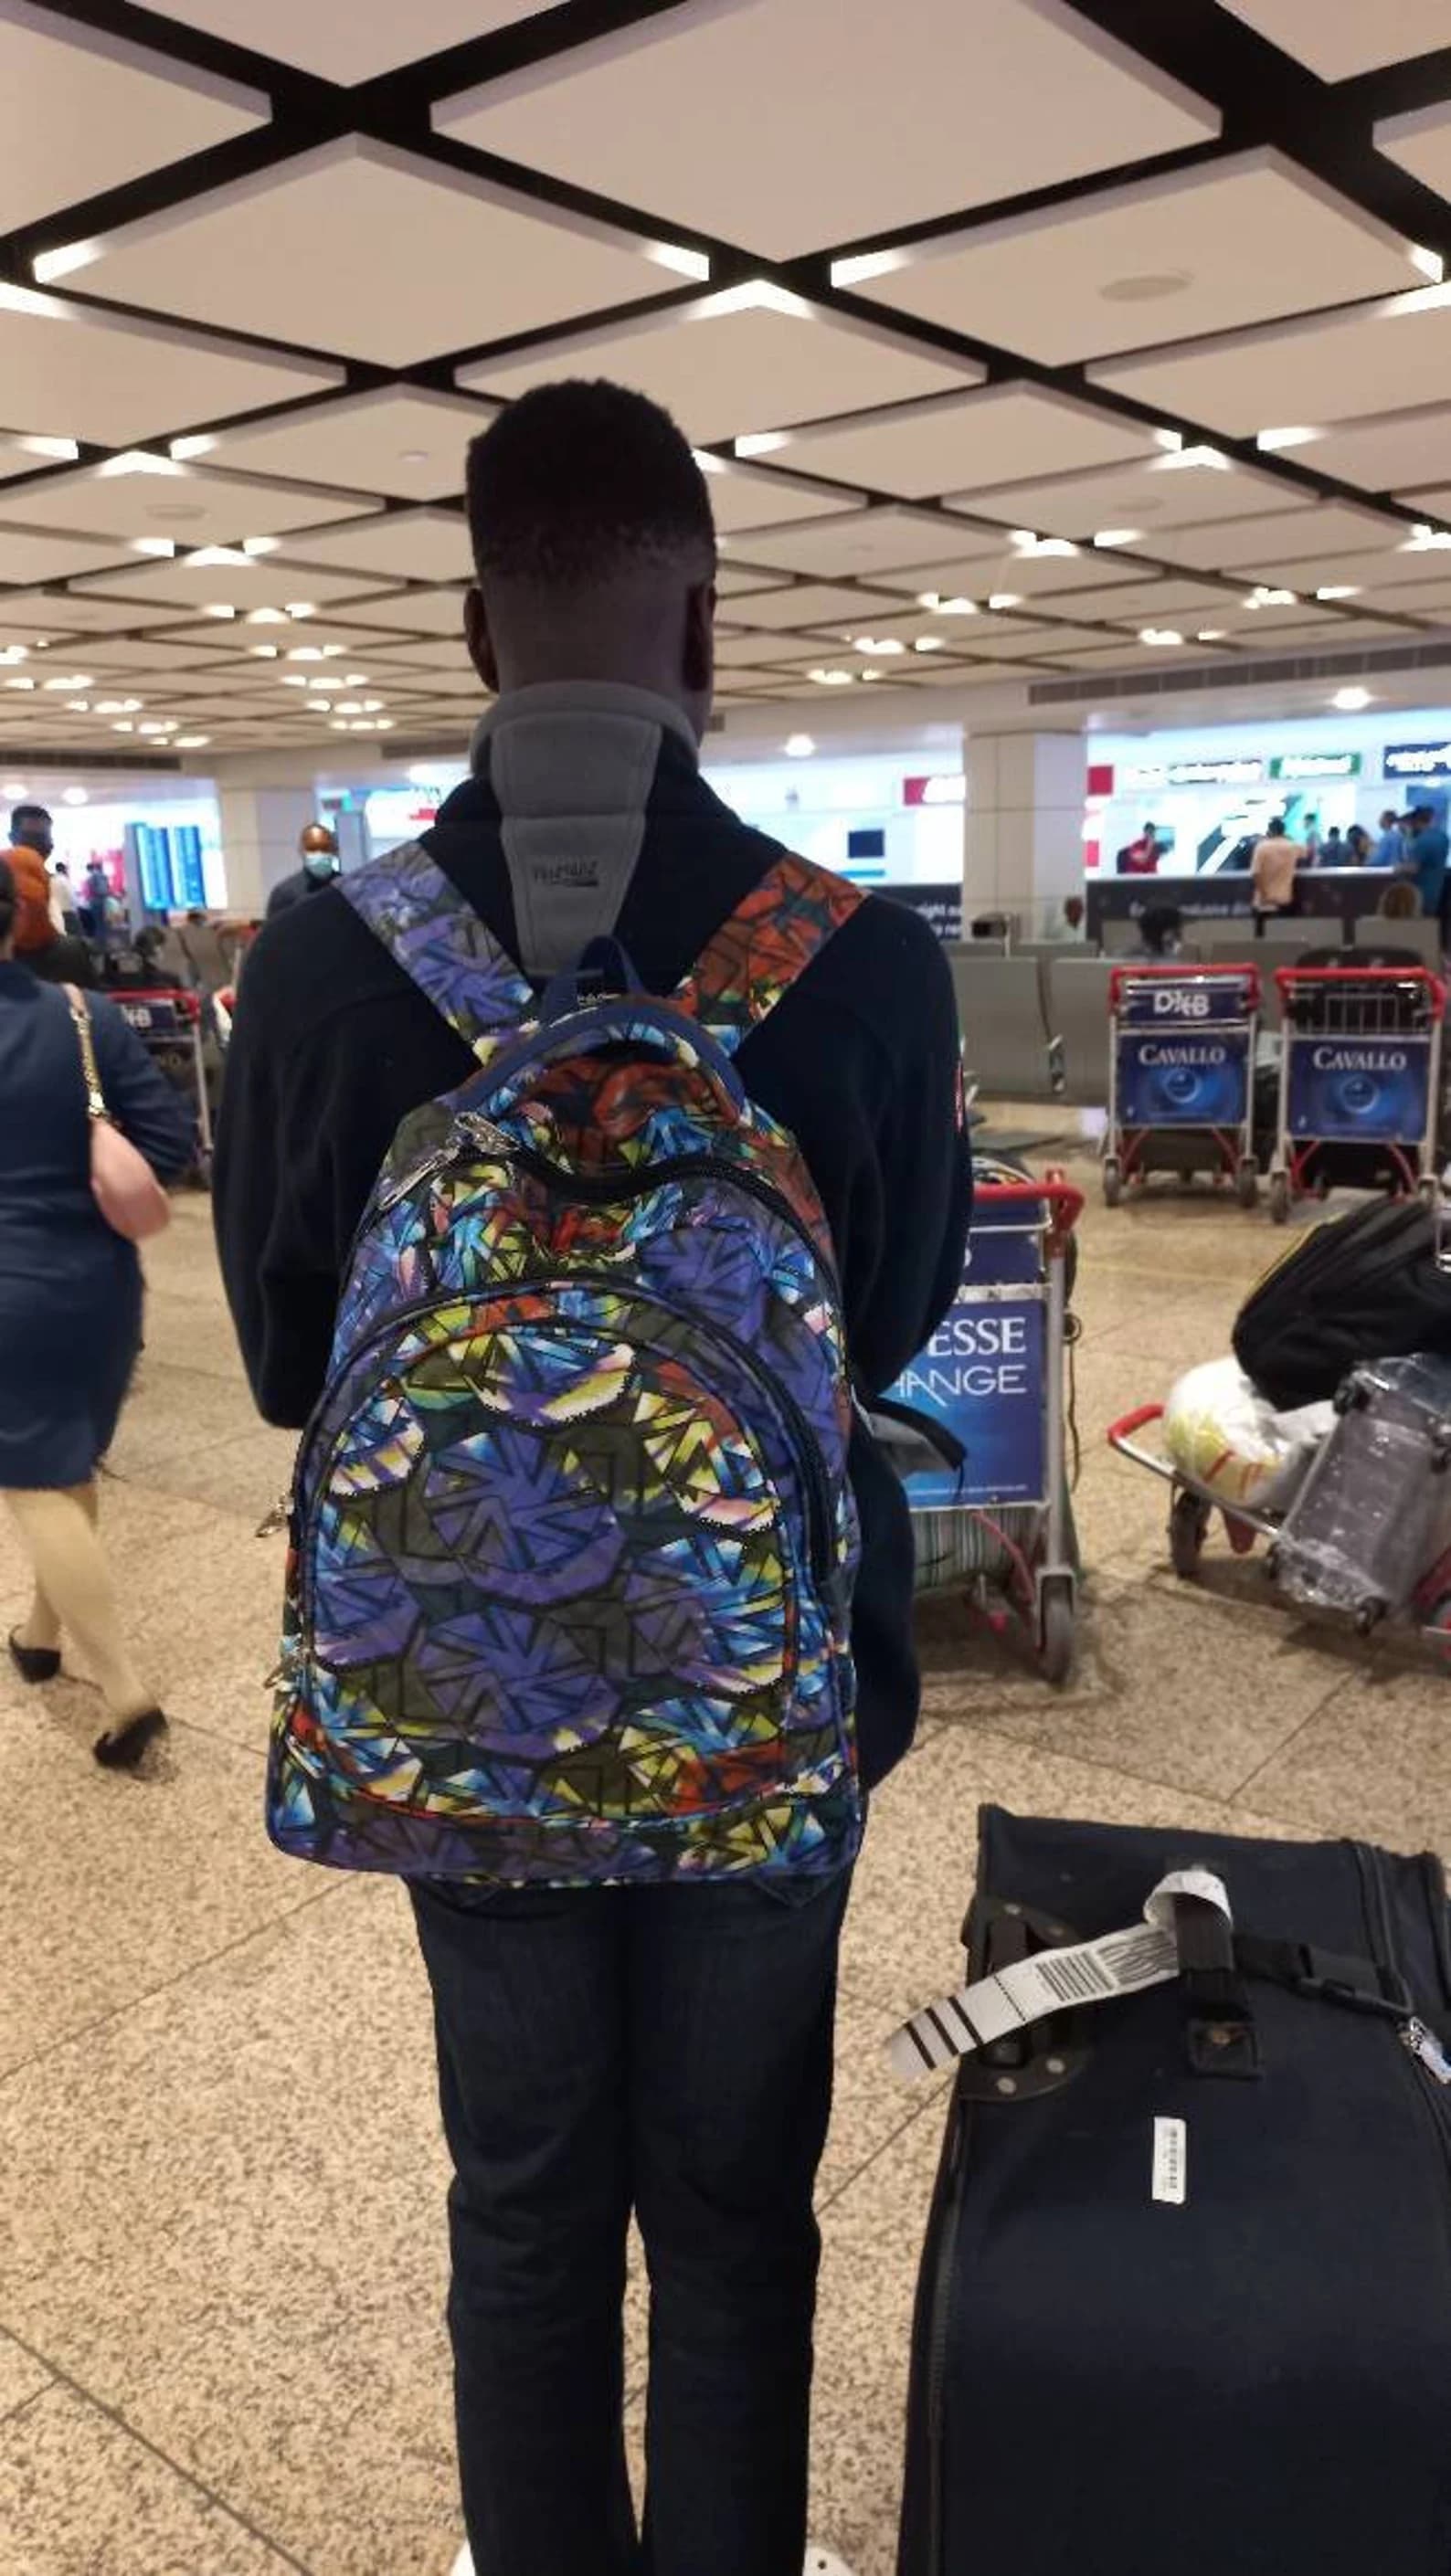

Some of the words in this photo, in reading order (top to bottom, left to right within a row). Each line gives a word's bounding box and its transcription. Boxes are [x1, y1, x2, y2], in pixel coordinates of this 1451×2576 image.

[1139, 1044, 1226, 1067] CAVALLO
[1313, 1046, 1407, 1072] CAVALLO
[893, 1364, 1027, 1408] HANGE
